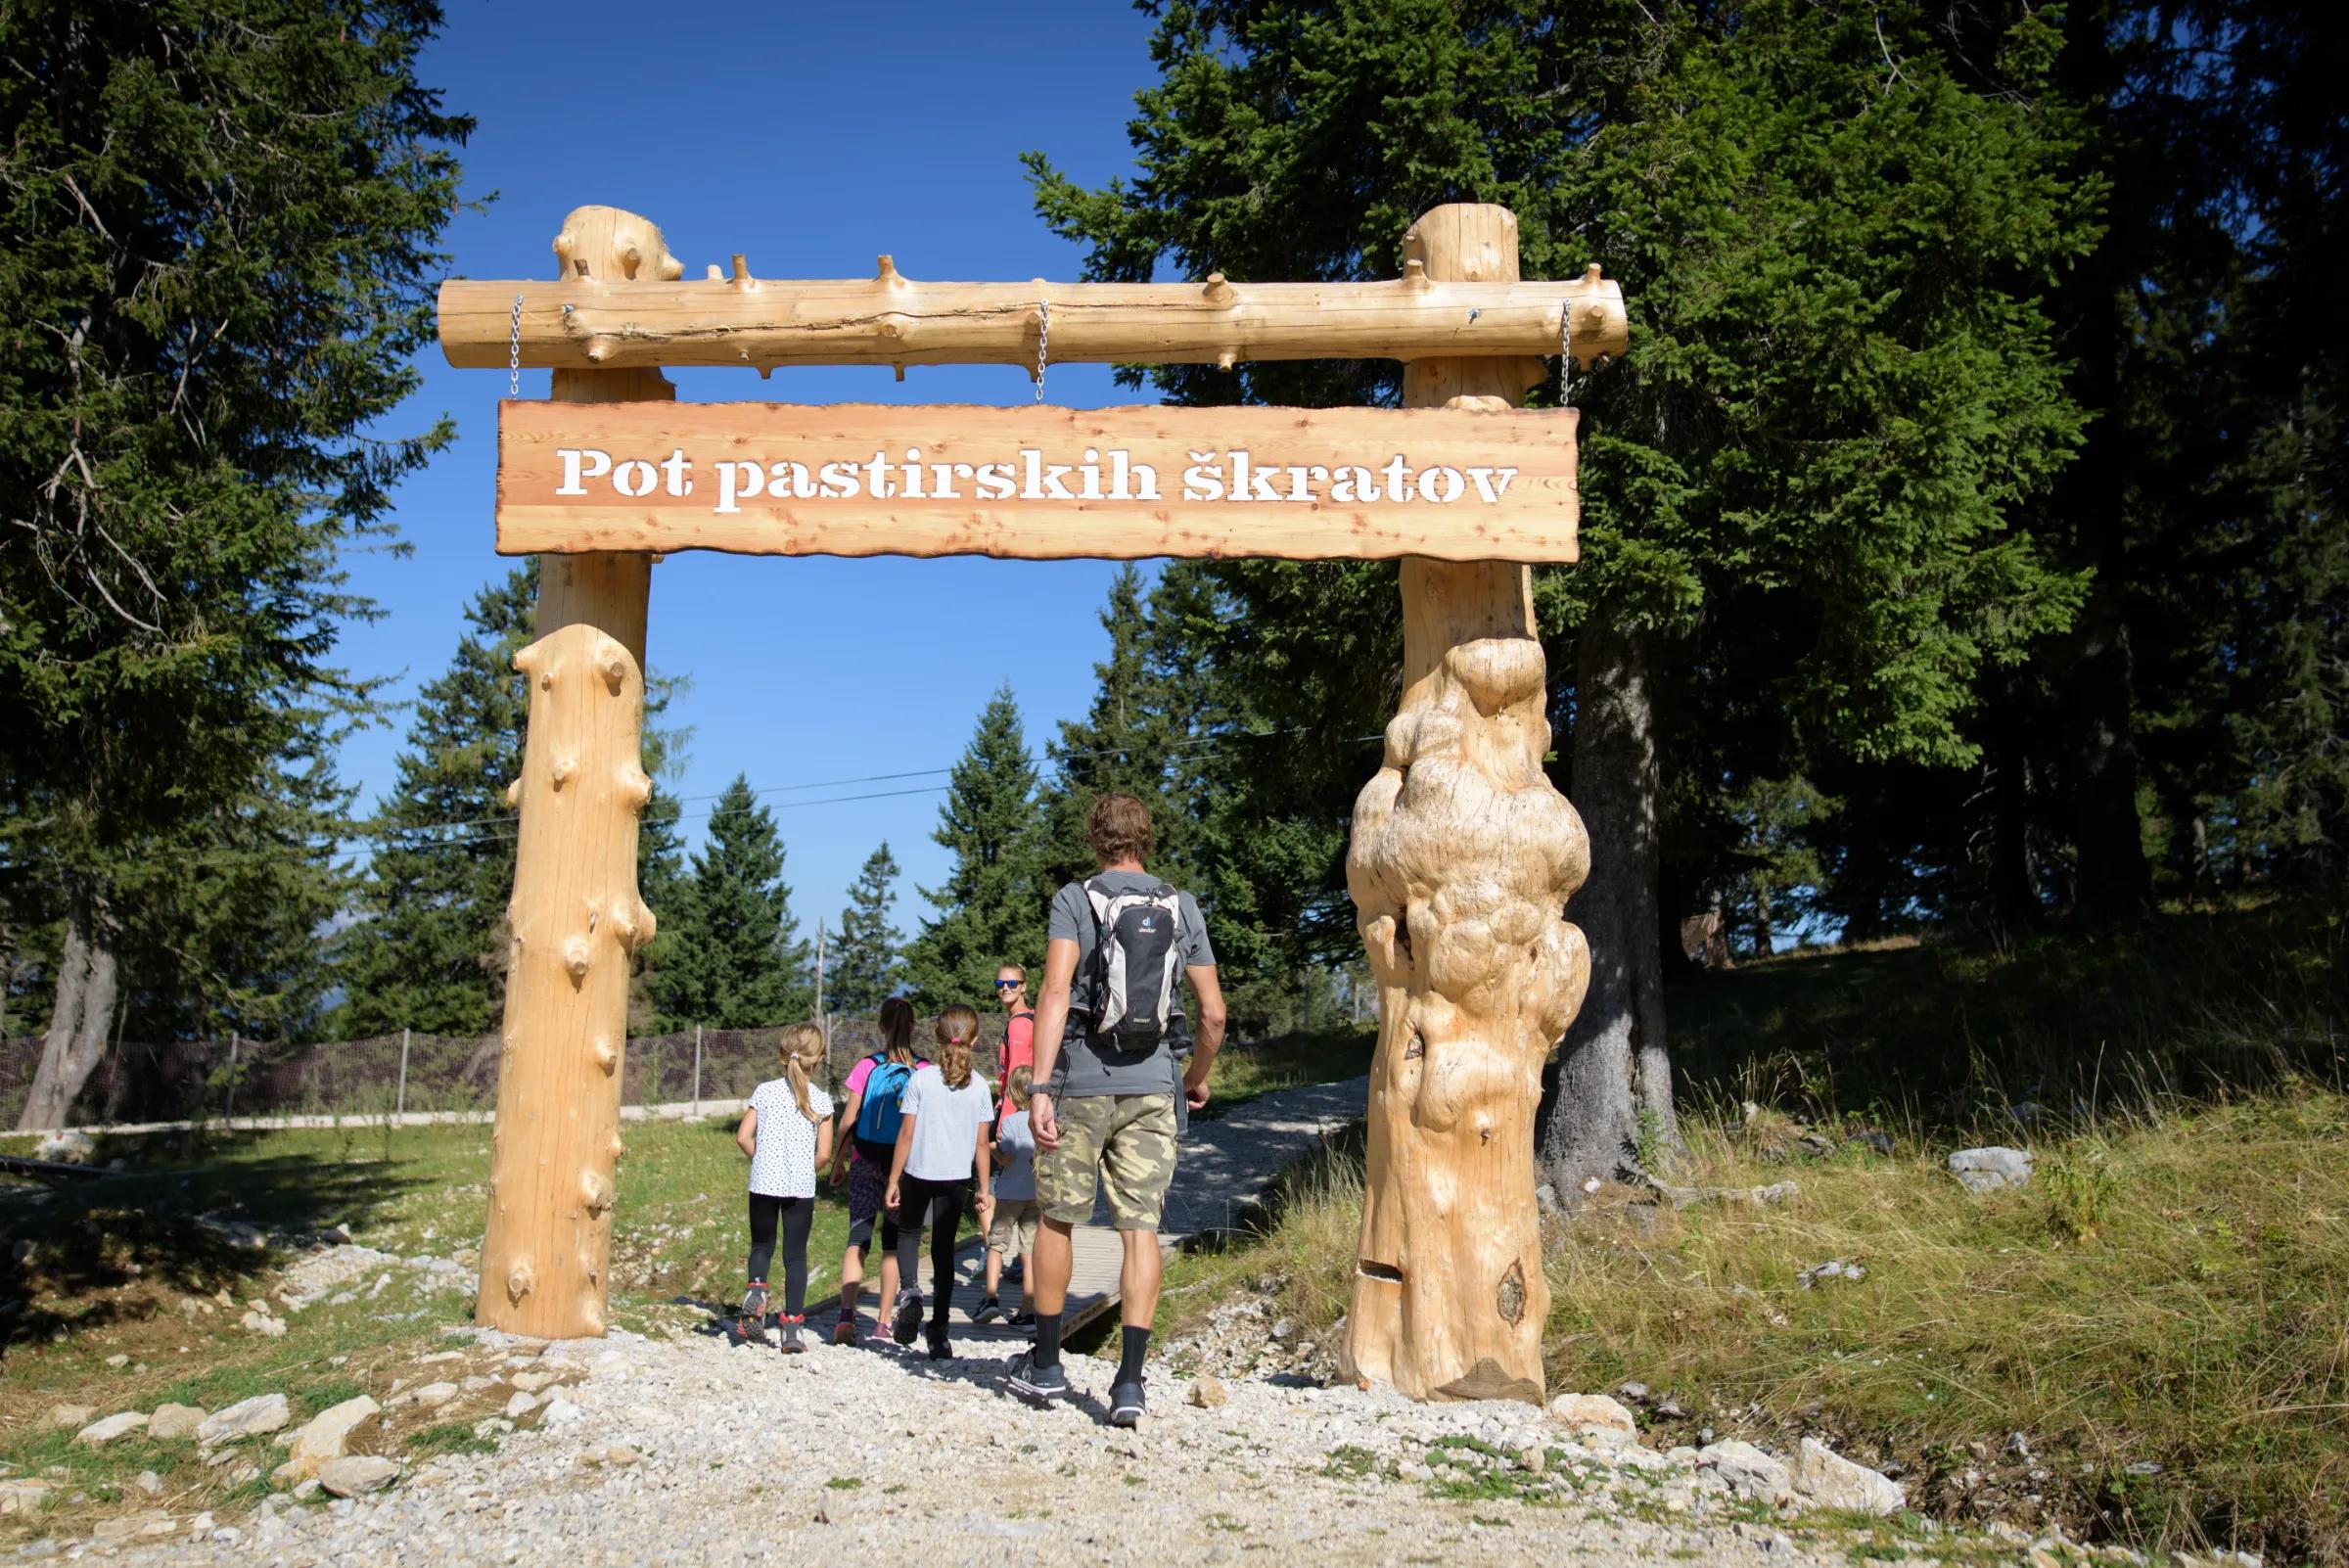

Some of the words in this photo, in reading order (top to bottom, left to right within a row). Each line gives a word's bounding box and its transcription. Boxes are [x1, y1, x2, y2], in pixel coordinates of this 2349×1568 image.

[555, 447, 693, 497] Pot
[714, 447, 1162, 513] pastirskih
[1182, 450, 1518, 503] škratov
